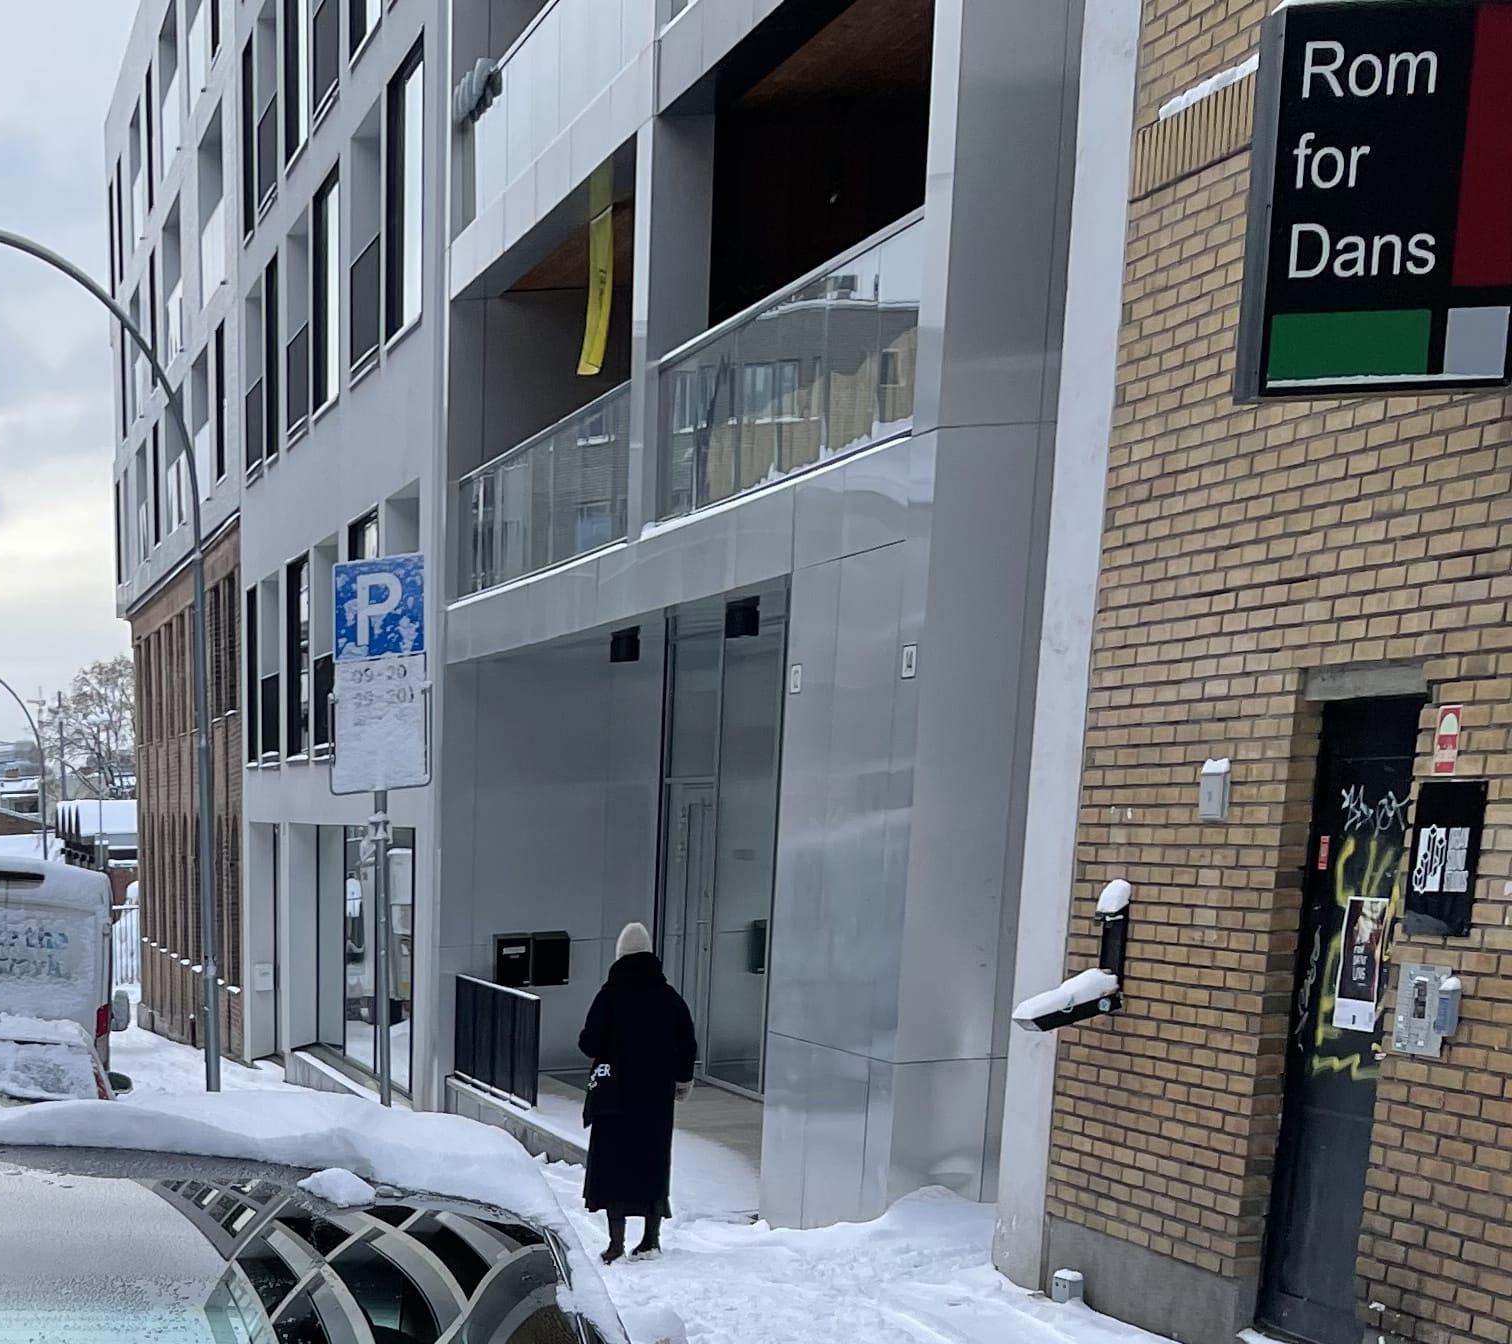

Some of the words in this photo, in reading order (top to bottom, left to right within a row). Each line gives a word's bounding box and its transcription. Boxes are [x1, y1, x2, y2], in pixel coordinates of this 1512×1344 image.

[1301, 40, 1437, 99] Rom
[1292, 132, 1370, 190] for
[1288, 222, 1436, 280] Dans
[356, 572, 402, 646] P
